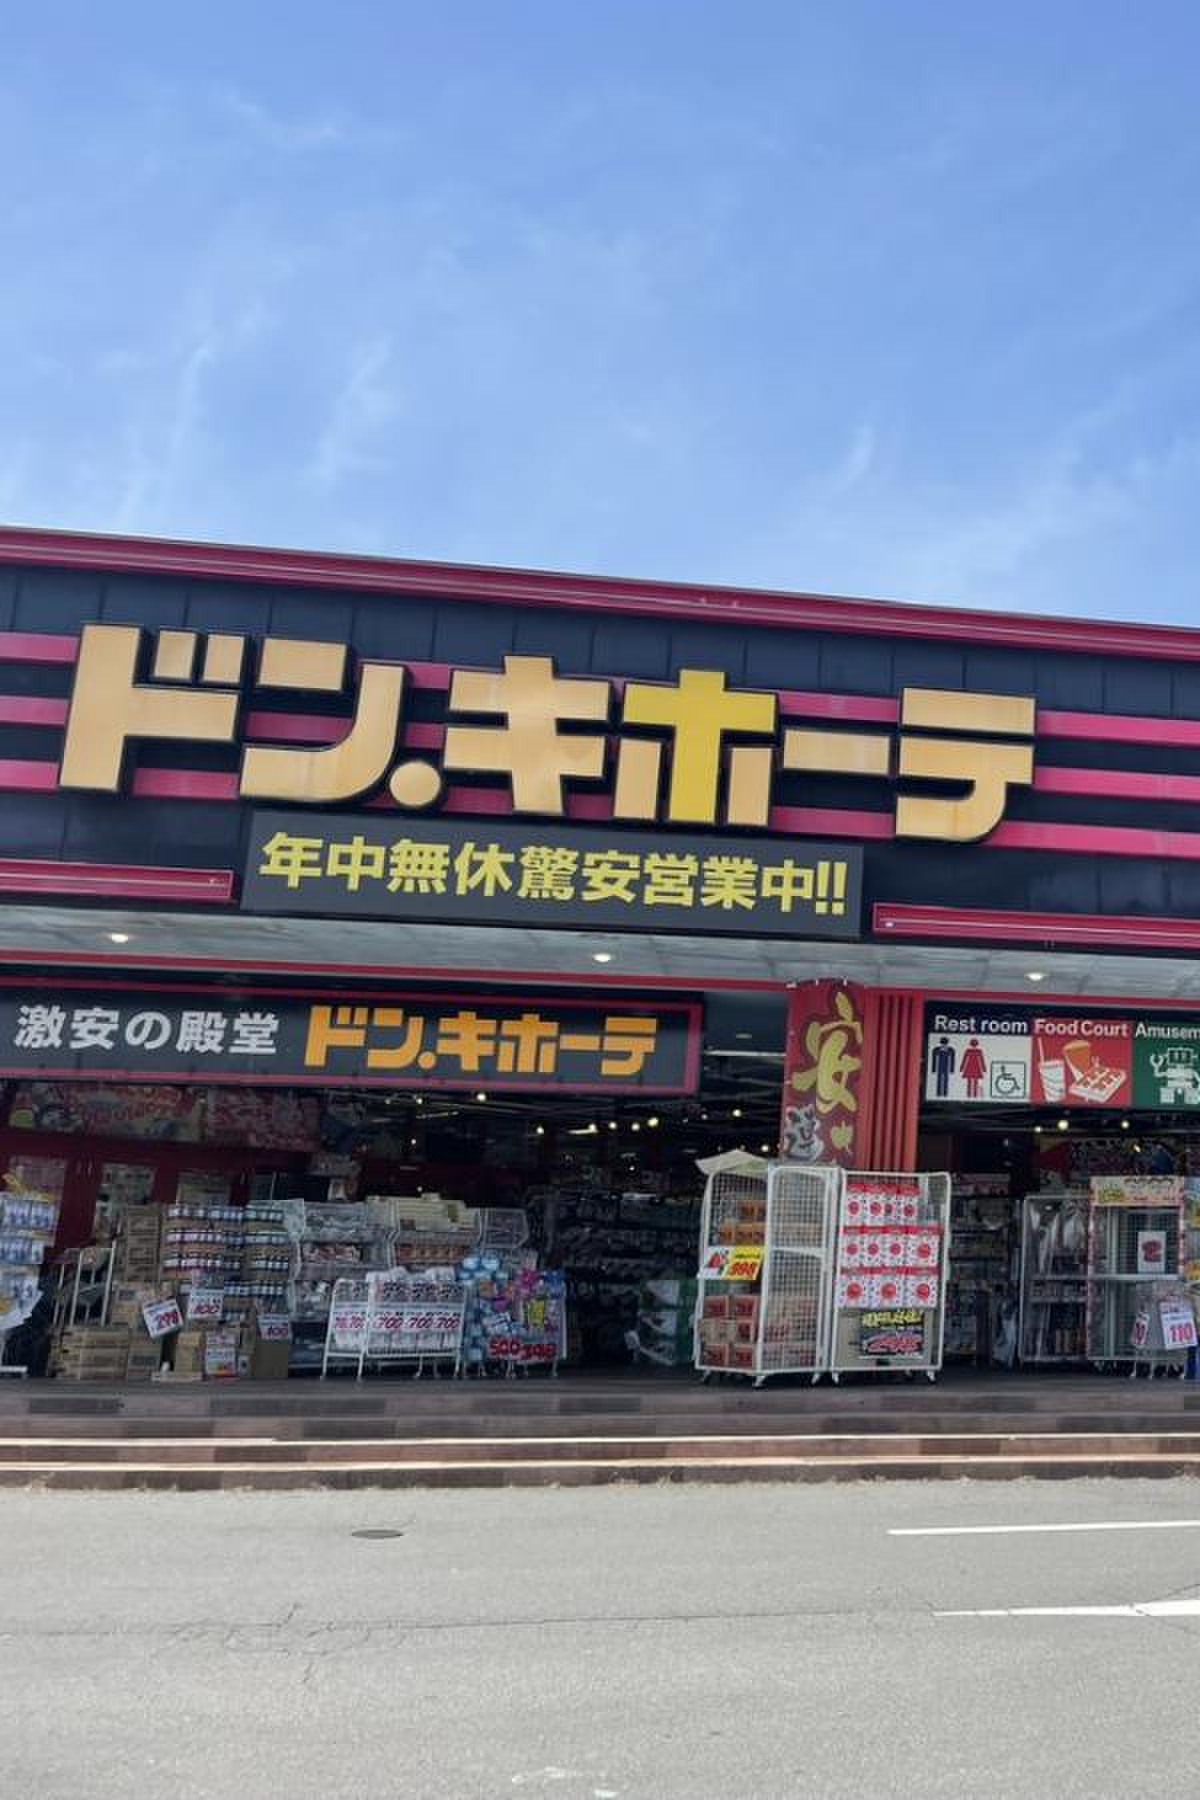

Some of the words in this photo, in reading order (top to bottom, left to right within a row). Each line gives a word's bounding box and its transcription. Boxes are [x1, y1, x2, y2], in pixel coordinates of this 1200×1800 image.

[14, 1005, 279, 1054] 激安の殿堂
[934, 1015, 976, 1032] Rest
[981, 1018, 1028, 1033] room
[1034, 1019, 1076, 1035] Food
[1080, 1021, 1128, 1037] Court
